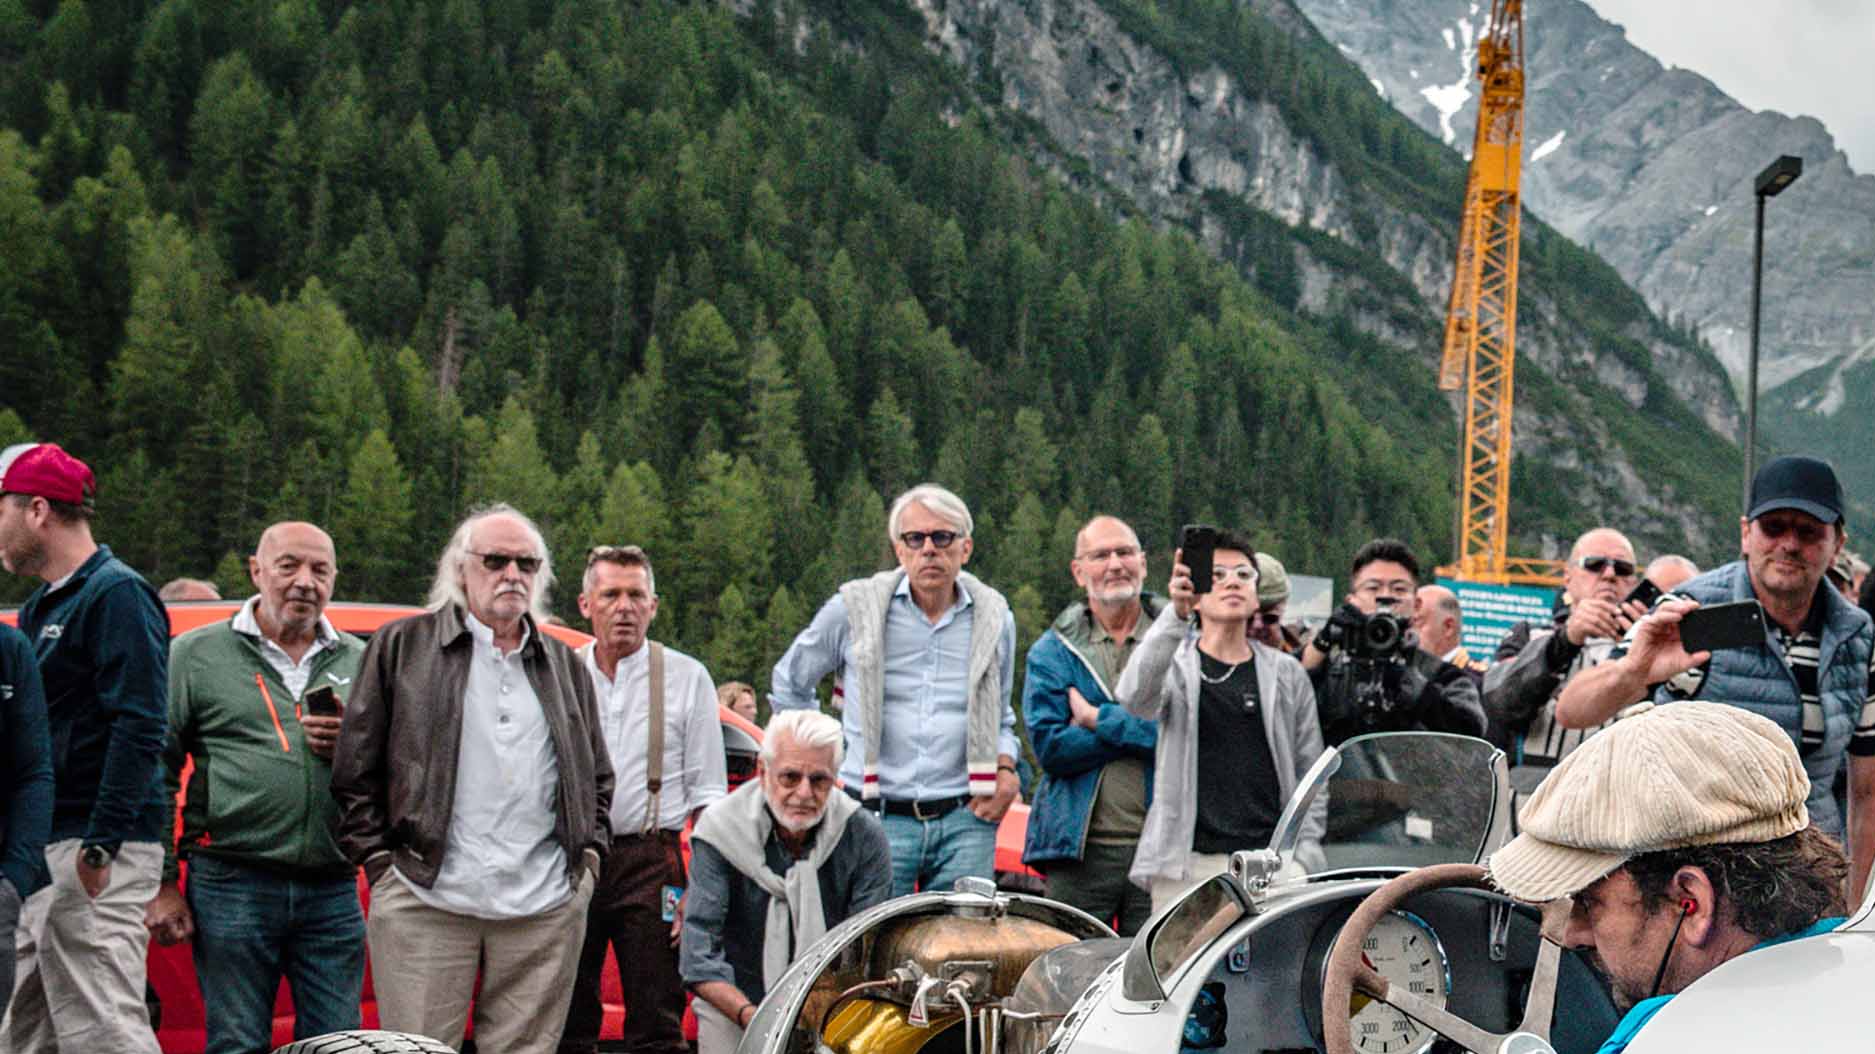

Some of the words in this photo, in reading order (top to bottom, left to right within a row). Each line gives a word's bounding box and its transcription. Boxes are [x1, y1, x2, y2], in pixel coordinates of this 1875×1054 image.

[1409, 981, 1424, 993] 1000
[1361, 1022, 1379, 1034] 3000
[1392, 1020, 1410, 1032] 2000
